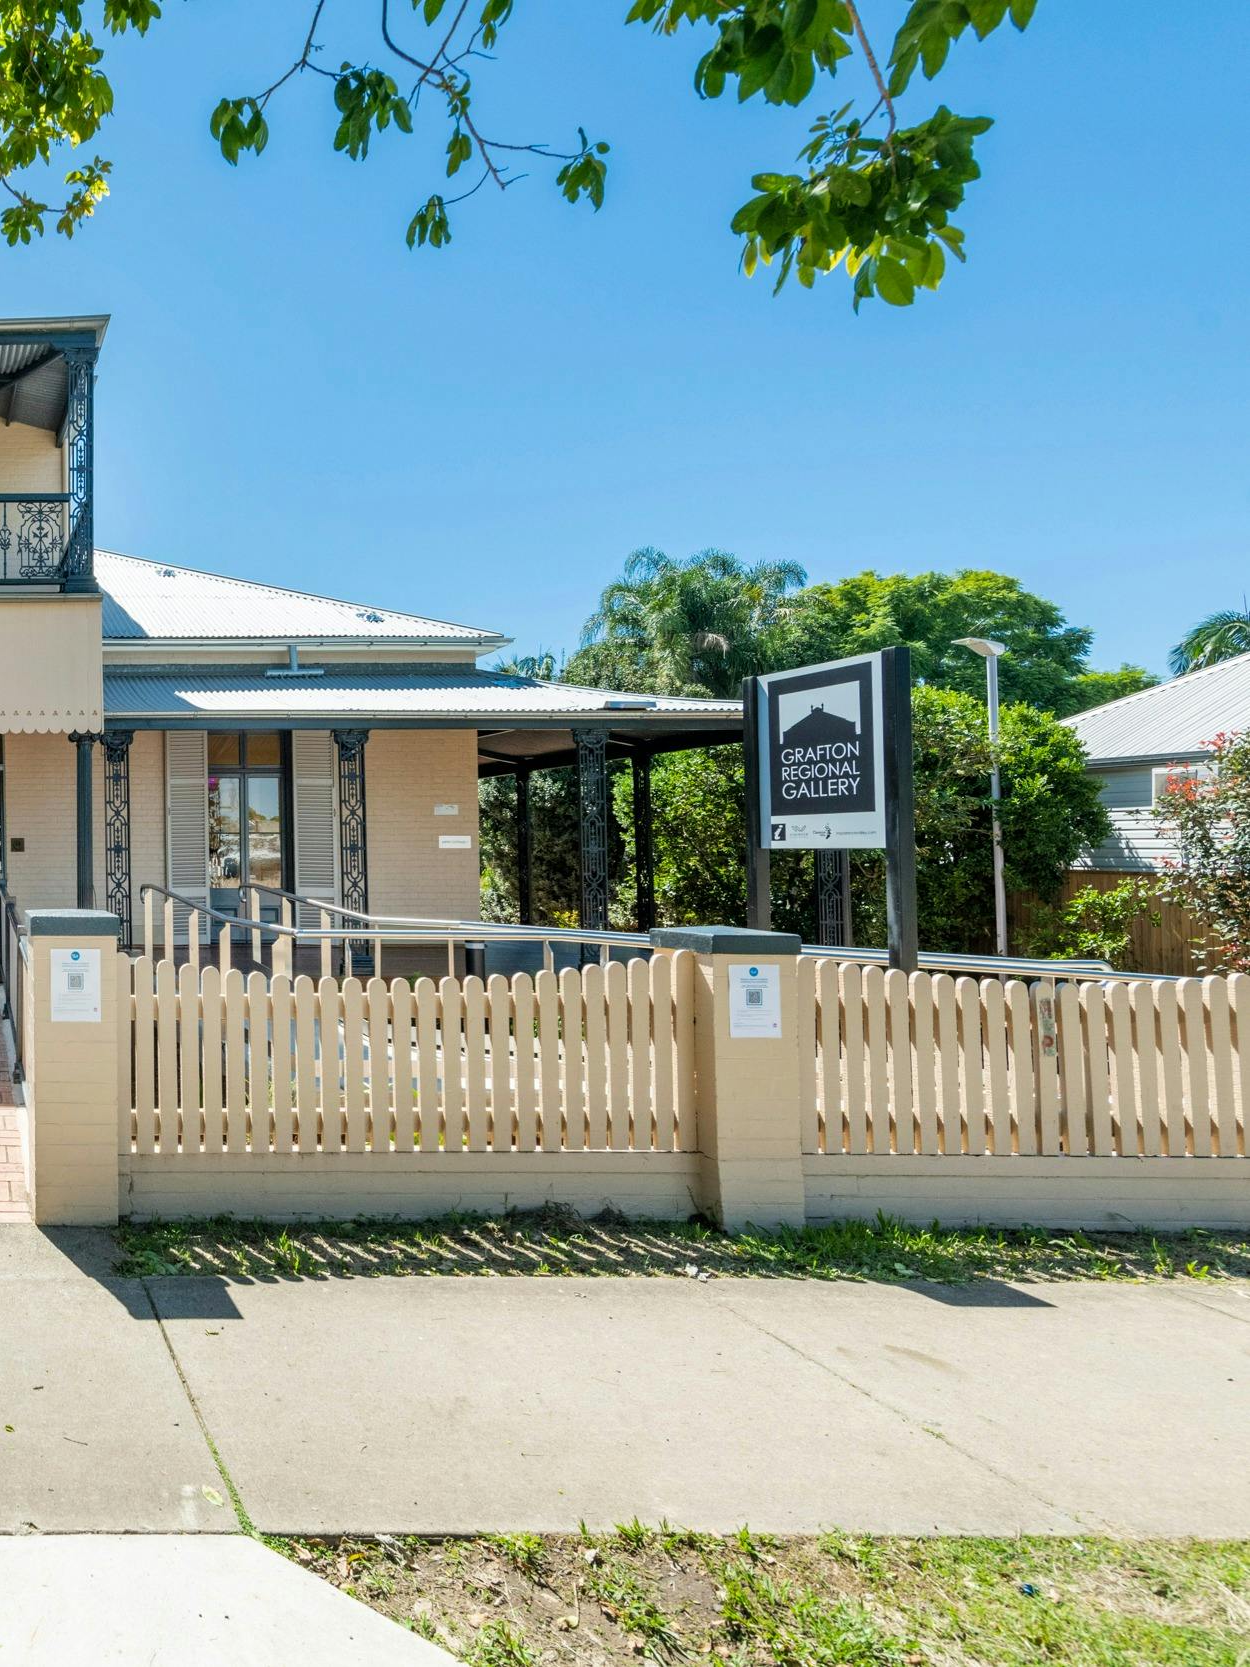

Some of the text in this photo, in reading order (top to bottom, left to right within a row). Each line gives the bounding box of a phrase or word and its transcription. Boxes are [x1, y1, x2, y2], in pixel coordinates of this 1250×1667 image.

[781, 741, 860, 764] GRAFTON
[782, 760, 861, 781] REGIONAL
[782, 777, 861, 800] GALLERY
